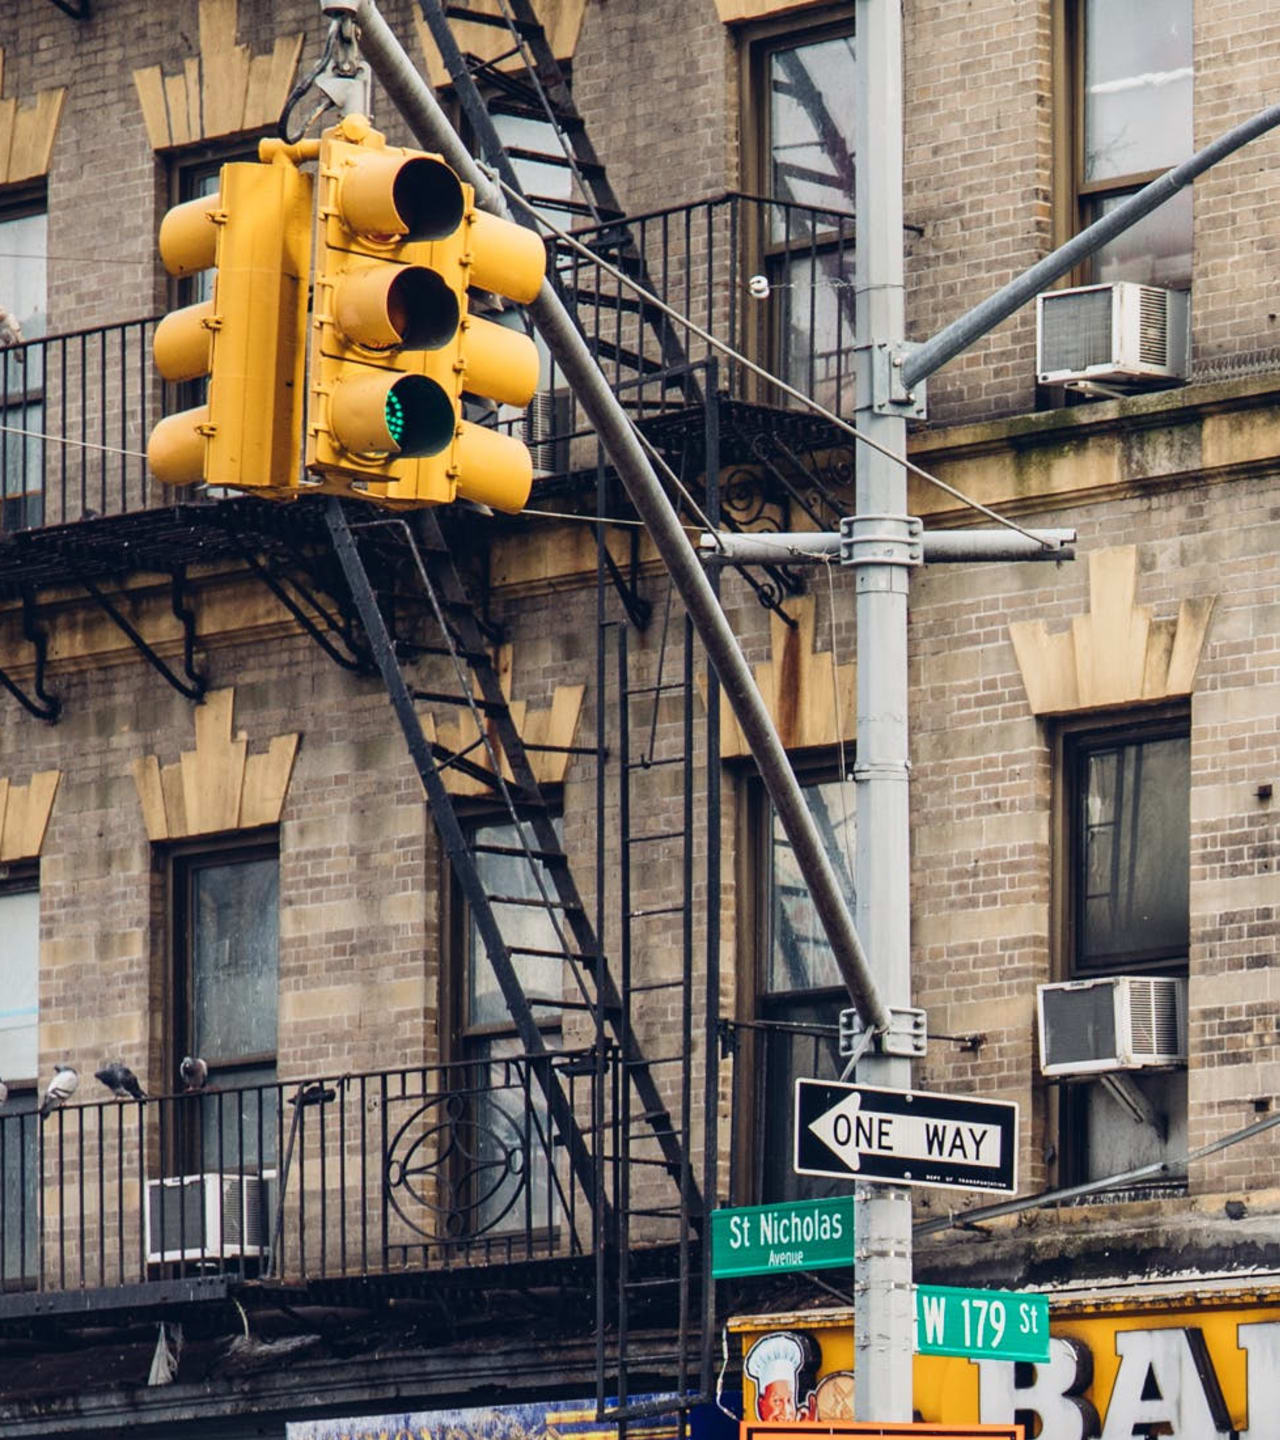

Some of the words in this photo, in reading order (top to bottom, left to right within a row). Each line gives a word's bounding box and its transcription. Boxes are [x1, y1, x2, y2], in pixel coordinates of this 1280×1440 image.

[833, 1113, 893, 1151] ONE
[925, 1123, 988, 1161] WAY
[730, 1216, 751, 1249] St
[759, 1208, 843, 1246] Nicholas
[768, 1249, 804, 1266] Avenue
[922, 1296, 947, 1346] W
[961, 1298, 1007, 1349] 179
[1019, 1302, 1039, 1335] St
